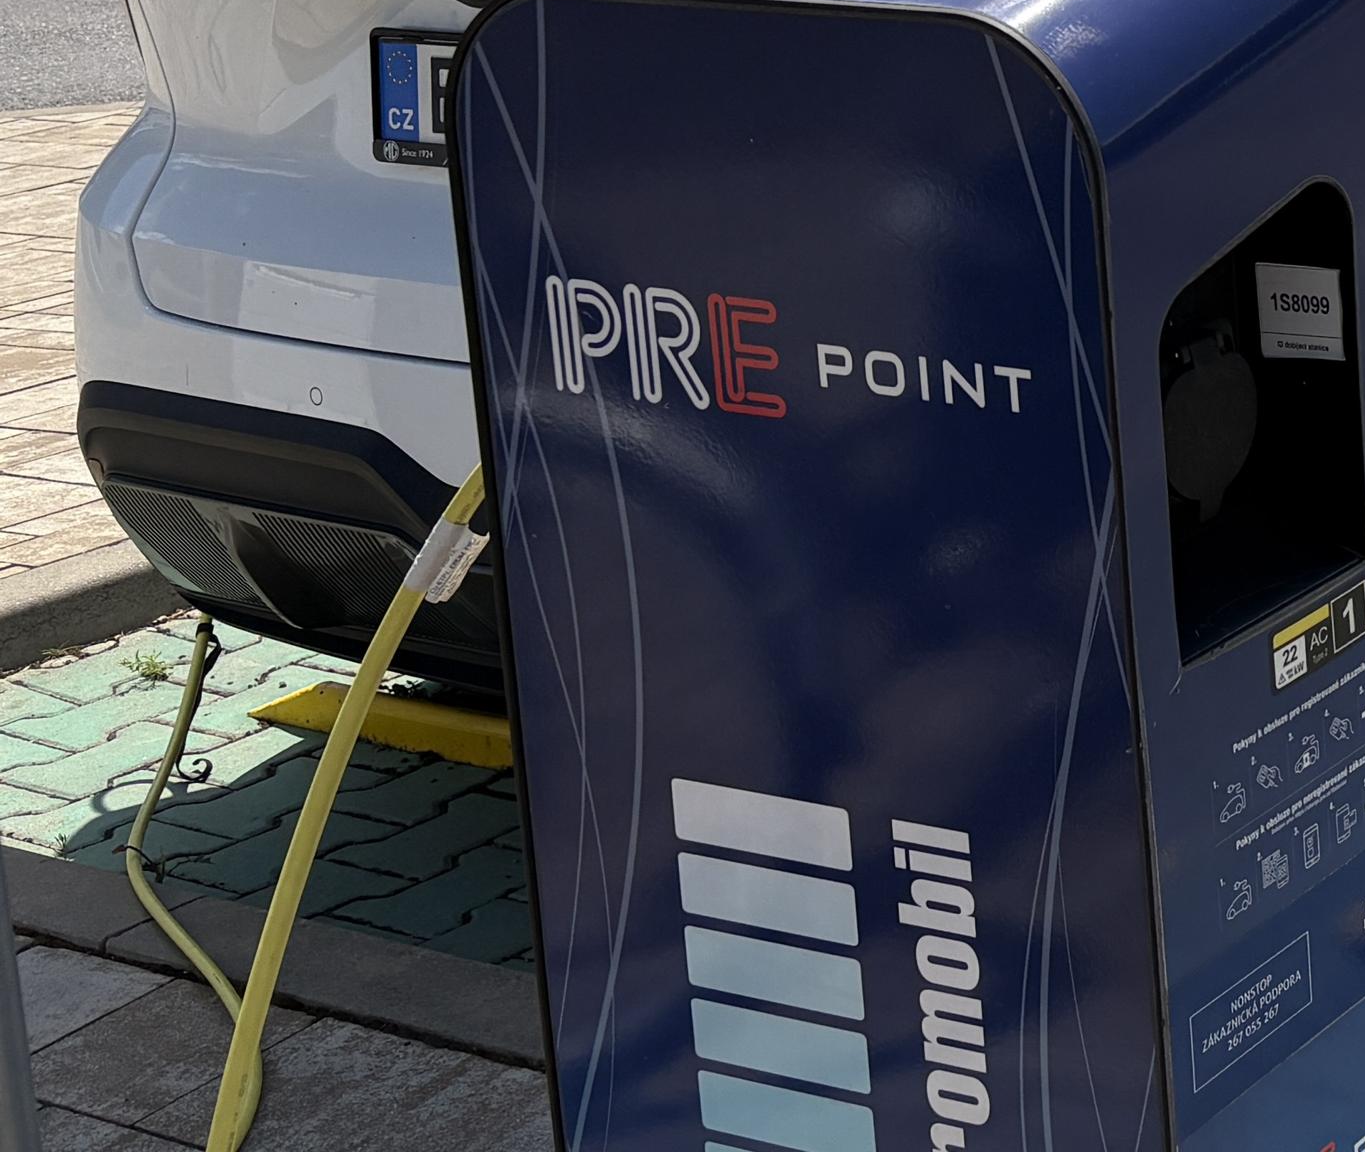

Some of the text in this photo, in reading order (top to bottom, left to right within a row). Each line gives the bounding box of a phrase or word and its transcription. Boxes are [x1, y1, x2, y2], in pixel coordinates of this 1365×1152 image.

[388, 107, 414, 130] CZ
[401, 149, 417, 158] Since
[418, 149, 433, 158] 1924
[1270, 292, 1330, 315] 1S8099
[545, 274, 1032, 419] PRE POINT
[1342, 598, 1356, 634] 1
[1310, 626, 1329, 651] AC
[1282, 645, 1298, 667] 22
[1230, 974, 1272, 1014] NONSTOP
[1202, 970, 1302, 1053] ZÁKAZNICKÁ PODPORA
[1227, 1003, 1279, 1052] 267 055 267
